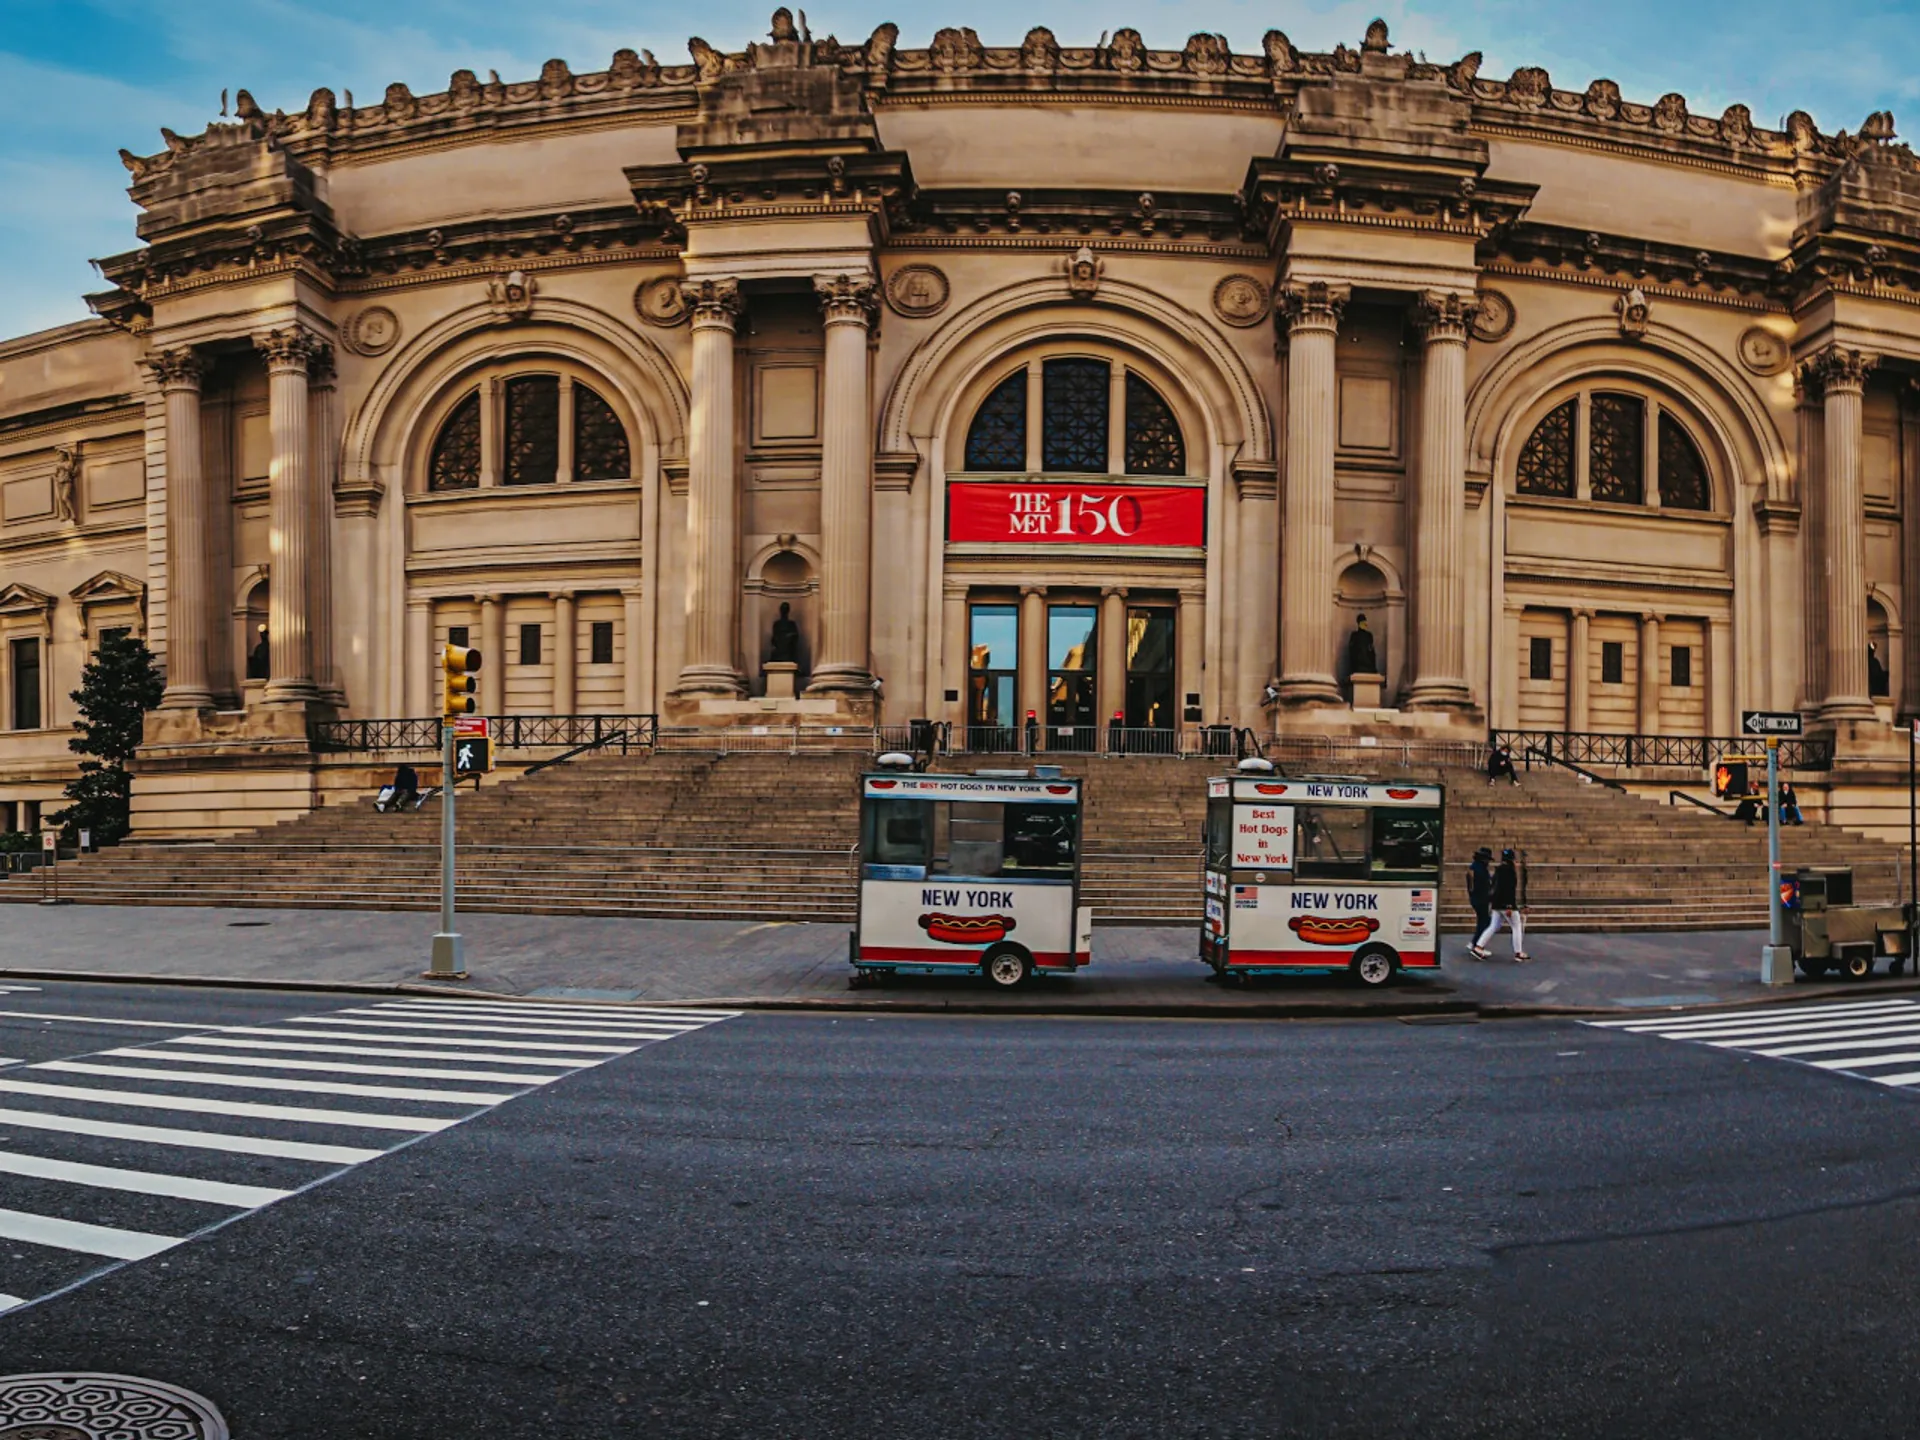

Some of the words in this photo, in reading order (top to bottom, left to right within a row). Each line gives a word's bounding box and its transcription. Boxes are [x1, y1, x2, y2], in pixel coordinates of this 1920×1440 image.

[1009, 492, 1050, 513] THE
[1052, 493, 1142, 537] 150
[1009, 514, 1052, 534] MET
[1752, 718, 1769, 729] ONE
[1776, 719, 1794, 729] WAY
[902, 781, 917, 789] THE
[960, 783, 982, 791] DOGS
[1307, 784, 1333, 797] NEW
[1337, 785, 1369, 798] YORK
[1252, 809, 1275, 819] Best
[1239, 824, 1258, 834] Hot
[1261, 824, 1288, 836] Dogs
[1258, 839, 1268, 848] in
[1237, 854, 1261, 863] New
[1265, 854, 1288, 863] York
[922, 889, 960, 906] NEW
[966, 891, 1014, 908] YORK
[1291, 892, 1329, 909] NEW
[1334, 894, 1378, 910] YORK
